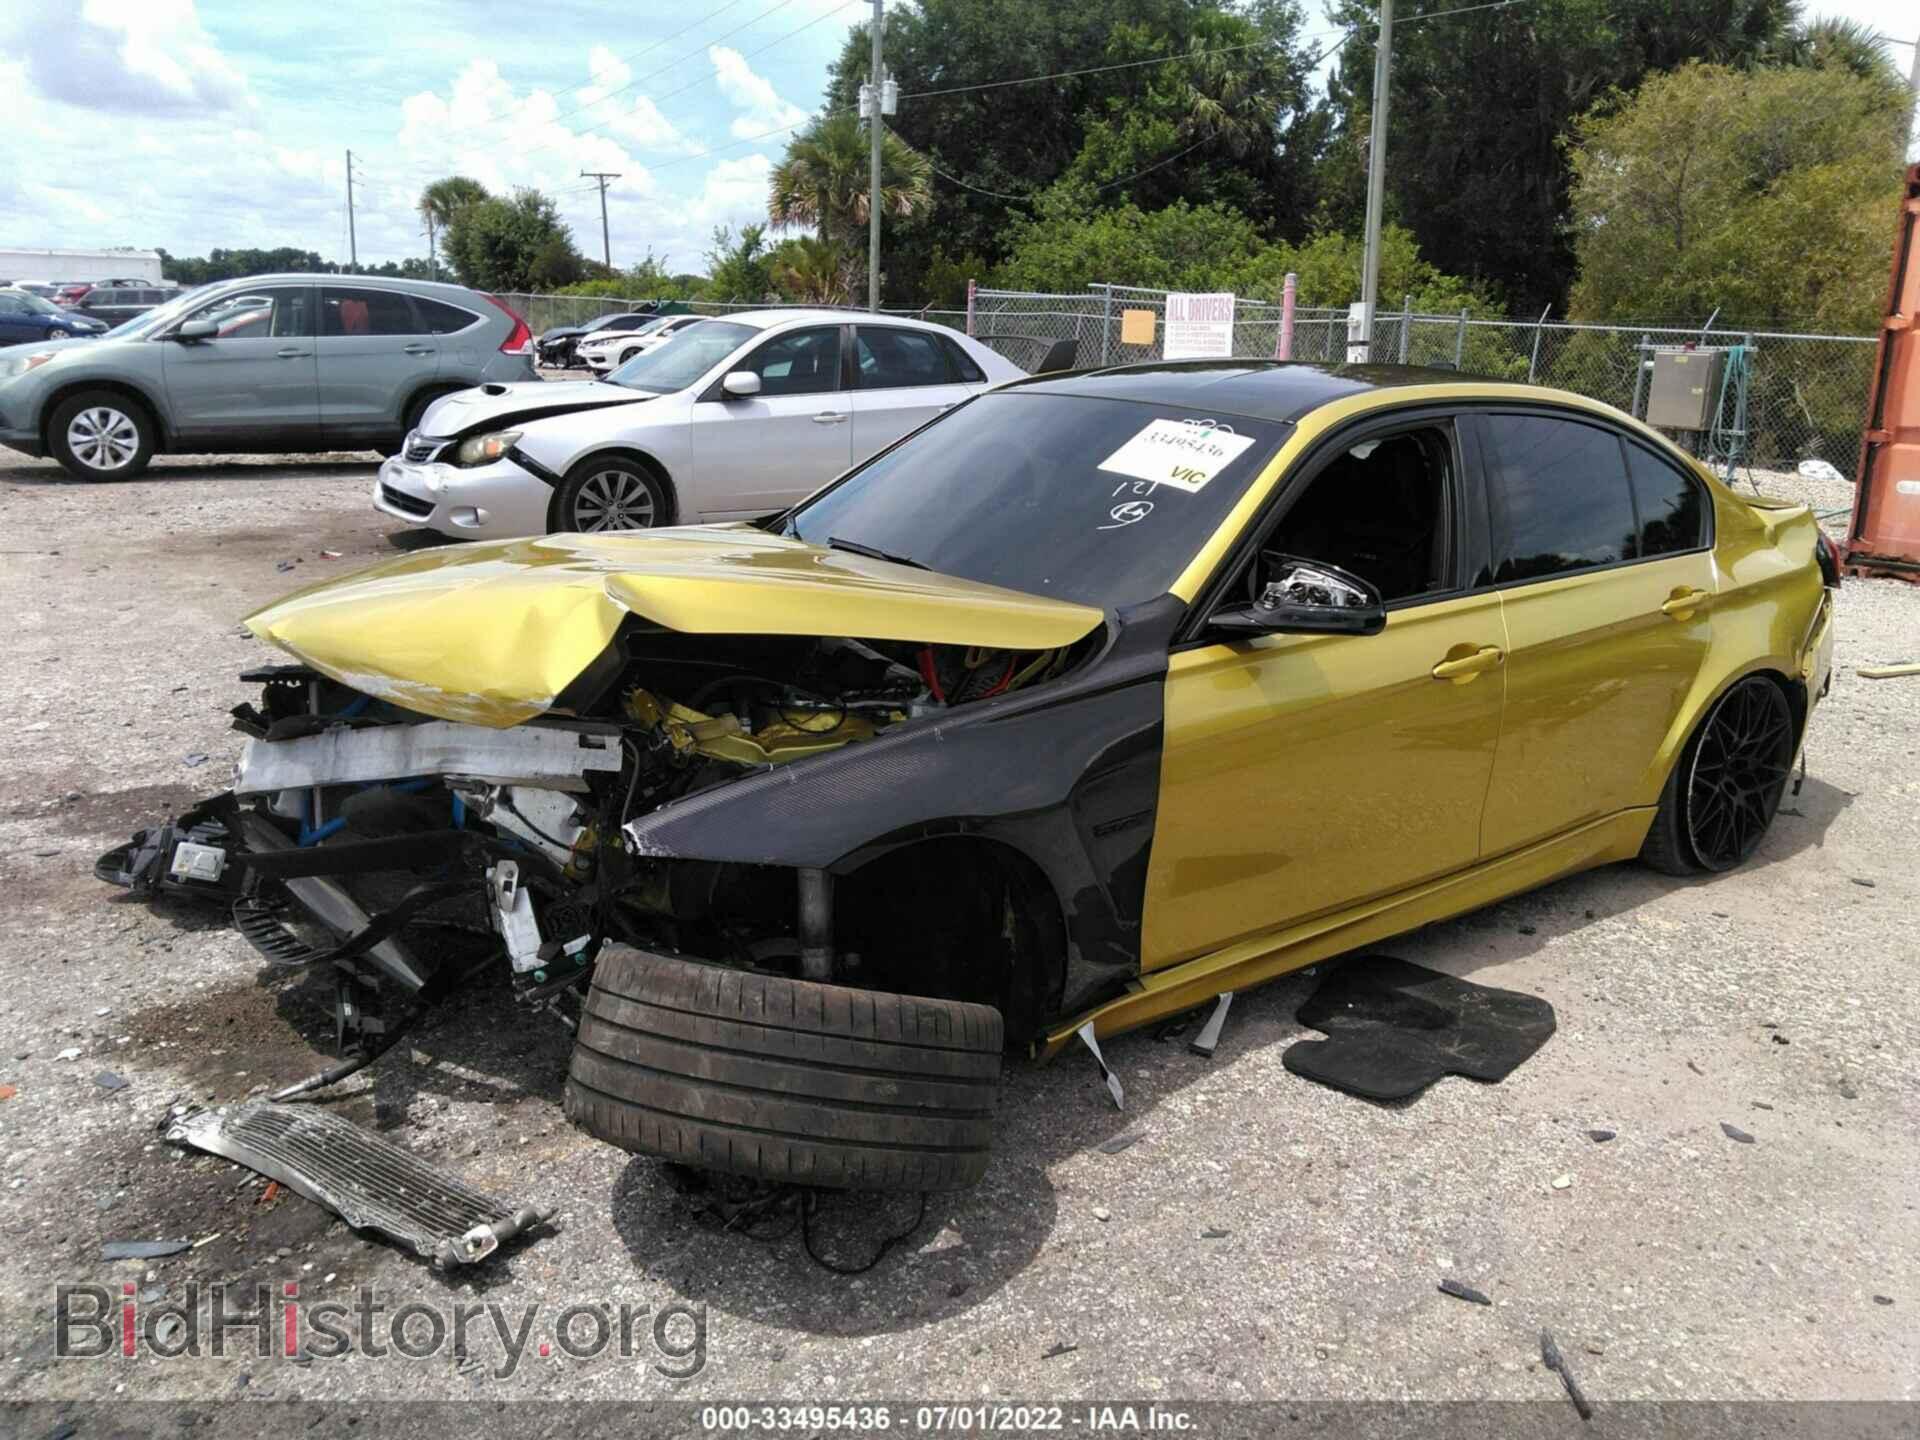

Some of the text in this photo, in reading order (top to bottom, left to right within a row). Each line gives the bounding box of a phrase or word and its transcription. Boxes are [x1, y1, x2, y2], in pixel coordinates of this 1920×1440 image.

[1168, 297, 1232, 321] ALL DRIVERS
[1171, 465, 1206, 484] VIC
